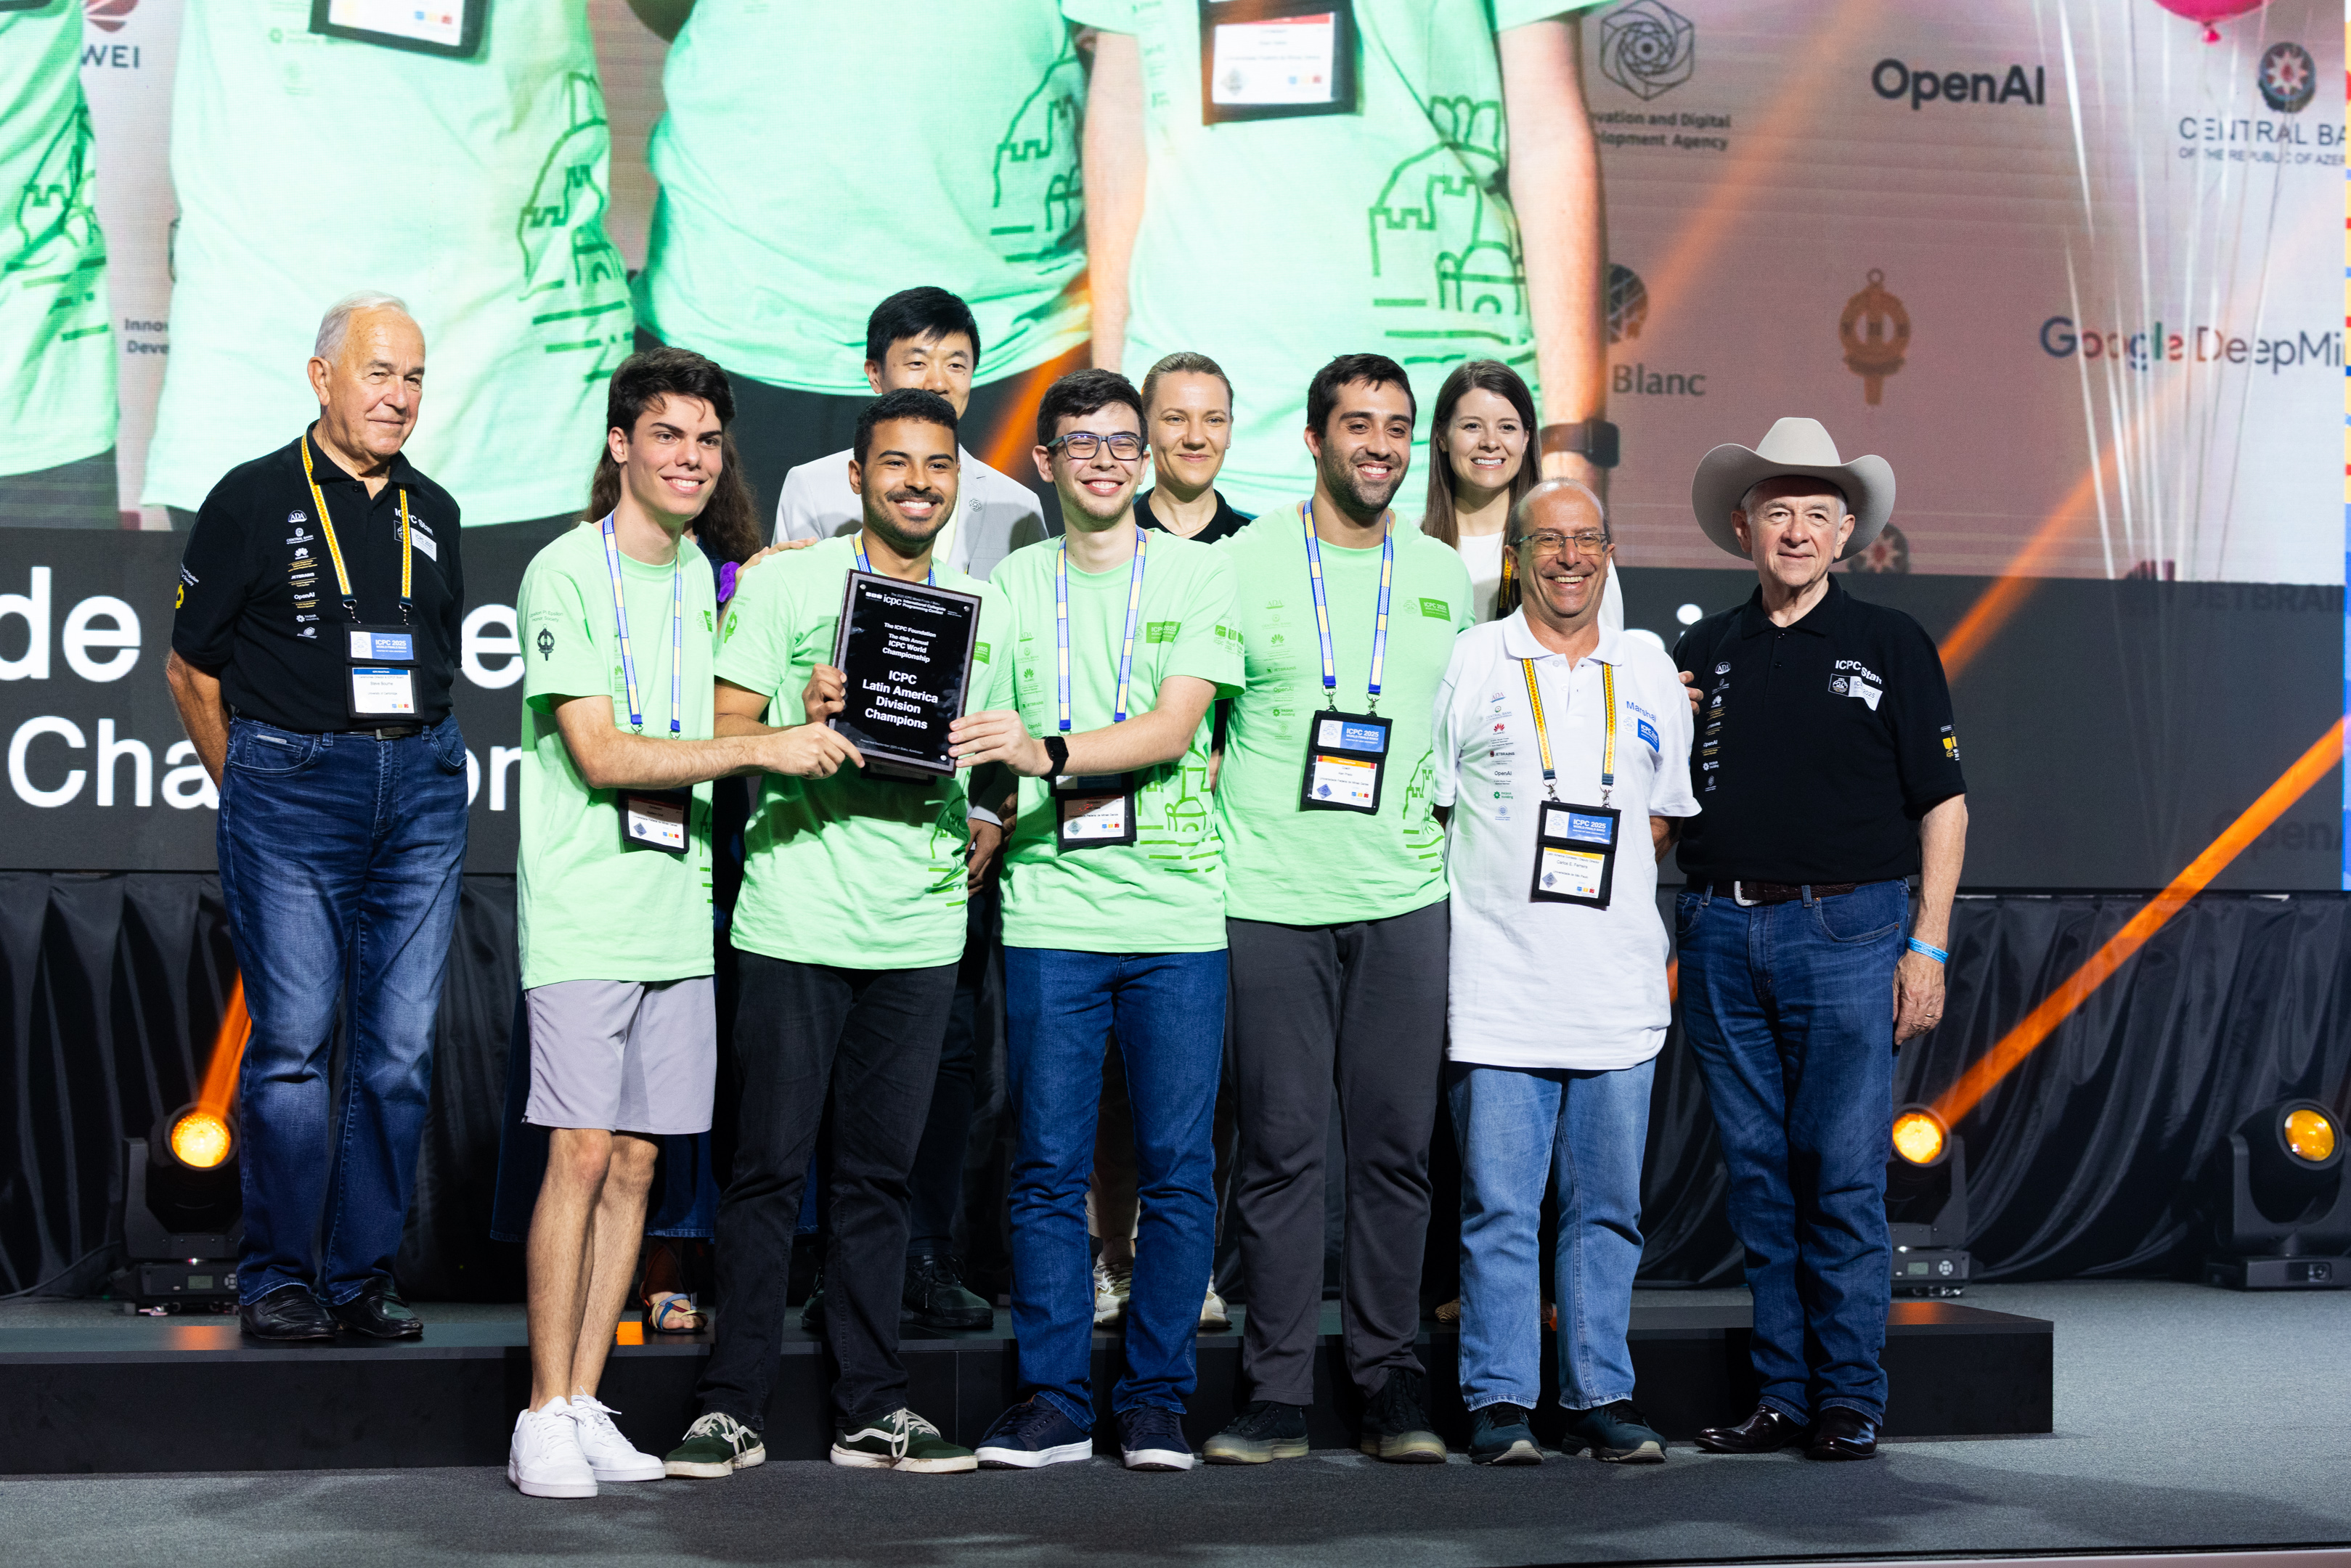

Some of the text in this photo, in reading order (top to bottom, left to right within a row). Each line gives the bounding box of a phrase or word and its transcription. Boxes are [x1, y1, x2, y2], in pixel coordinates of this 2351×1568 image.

[1872, 58, 2045, 110] OpenAI
[1648, 114, 1677, 126] and
[1681, 113, 1731, 128] Digital
[2179, 117, 2307, 144] CENTRAL
[1672, 134, 1728, 151] Agency
[2040, 317, 2344, 375] Google DeepMi
[1613, 363, 1706, 396] Blanc
[293, 592, 315, 600] OpenAI
[883, 594, 902, 606] icpc
[902, 599, 927, 608] International
[902, 603, 928, 613] Programming
[908, 627, 937, 637] Foundation
[888, 640, 927, 653] ICPC World
[882, 647, 931, 663] Championship
[1835, 660, 1862, 670] ICPC
[888, 670, 917, 685] ICPC
[862, 679, 939, 703] Latin America
[1491, 692, 1504, 701] ADA
[1862, 689, 1875, 698] 2025
[876, 695, 921, 714] Division
[1626, 701, 1657, 723] Marshal
[865, 708, 928, 730] Champions
